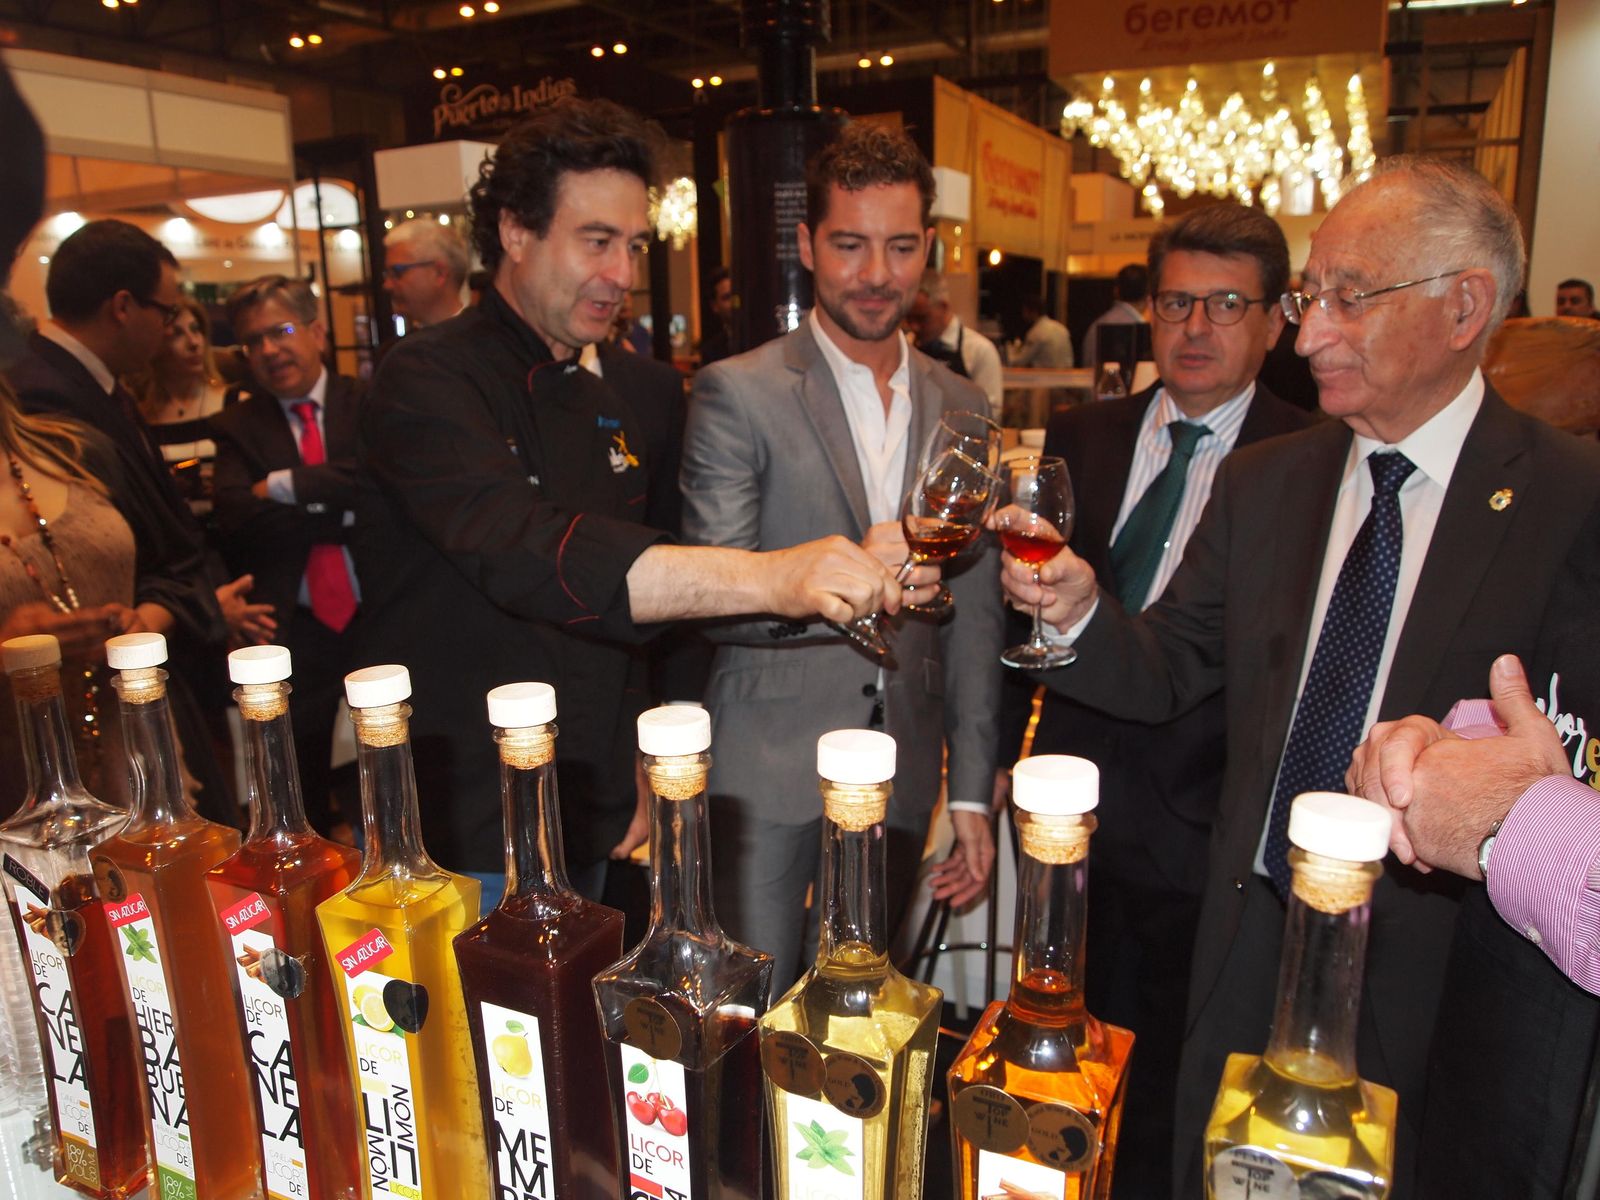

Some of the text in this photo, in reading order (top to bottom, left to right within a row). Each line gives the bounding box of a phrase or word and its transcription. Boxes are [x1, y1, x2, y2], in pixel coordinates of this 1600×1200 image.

[1124, 0, 1297, 36] бегемот
[9, 860, 45, 898] ROBLE
[108, 909, 121, 922] SIN
[225, 899, 266, 929] SIN AZÚCAR
[31, 949, 65, 972] LICOR
[341, 936, 389, 971] SIN AZÚCAR
[33, 963, 49, 979] DE
[132, 986, 148, 1003] DE
[243, 994, 284, 1020] LICOR
[246, 1009, 263, 1026] DE
[358, 1041, 403, 1066] LICOR
[359, 1057, 379, 1075] DE
[493, 1080, 542, 1110] LICOR
[494, 1097, 515, 1117] DE
[78, 1121, 90, 1135] DE
[66, 1142, 88, 1166] 18%
[176, 1152, 189, 1167] DE
[631, 1133, 685, 1170] LICOR
[633, 1153, 654, 1175] DE
[163, 1173, 185, 1199] 18%
[289, 1180, 303, 1196] DE
